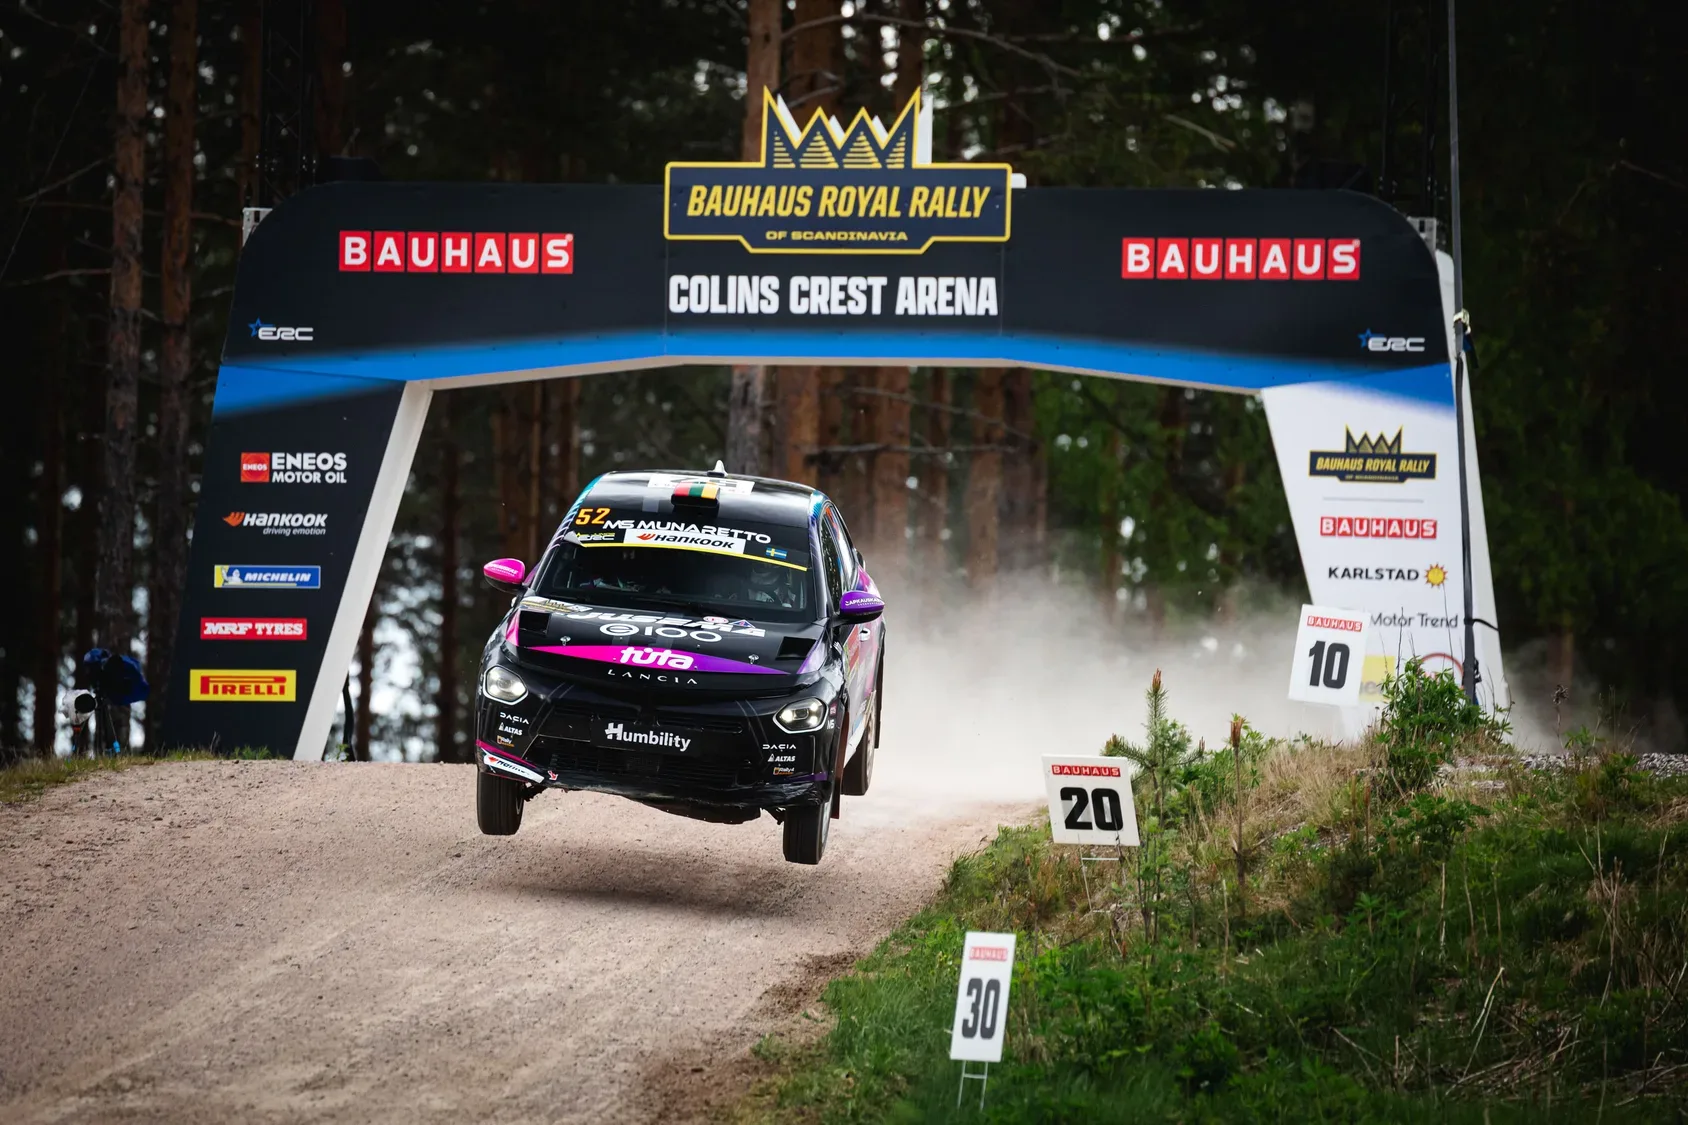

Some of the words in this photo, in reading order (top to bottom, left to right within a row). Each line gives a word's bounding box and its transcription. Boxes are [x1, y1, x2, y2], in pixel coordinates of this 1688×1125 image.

[687, 185, 813, 217] BAUHAUS
[818, 186, 901, 218] ROYAL
[909, 186, 991, 218] RALLY
[765, 231, 787, 241] OF
[791, 231, 908, 241] SCANDINAVIA
[343, 236, 570, 268] BAUHAUS
[1126, 242, 1357, 275] BAUHAUS
[668, 275, 780, 314] COLINS
[789, 276, 887, 315] CREST
[895, 276, 999, 316] ARENA
[258, 326, 314, 341] ERC
[1367, 336, 1426, 352] ERC
[242, 463, 268, 471] ENEOS
[272, 452, 347, 470] ENEOS
[1316, 457, 1363, 471] BAUHAUS
[1365, 459, 1397, 472] ROYAL
[1399, 459, 1430, 473] RALLY
[272, 471, 321, 483] MOTOR
[325, 471, 347, 484] OIL
[575, 508, 611, 525] 52
[263, 527, 291, 536] driving
[292, 527, 326, 535] emotion
[602, 520, 635, 529] MS
[636, 520, 772, 544] MUNARETTO
[1322, 518, 1437, 538] BAUHAUS
[244, 572, 312, 582] MICHELIN
[1328, 567, 1419, 581] KARLSTAD
[1307, 616, 1362, 632] BAUHAUS
[1369, 612, 1415, 627] Motor
[1417, 612, 1458, 628] Trend
[204, 622, 252, 635] MRF
[255, 623, 303, 635] TYRES
[1308, 640, 1350, 690] 10
[608, 669, 697, 684] LANCIA
[200, 676, 287, 695] PIRELLI
[500, 712, 529, 724] DACIA
[504, 726, 522, 736] ALTAS
[605, 723, 691, 752] Humbility
[1052, 766, 1120, 776] BAUHAUS
[1060, 787, 1123, 831] 20
[962, 978, 1001, 1040] 30
